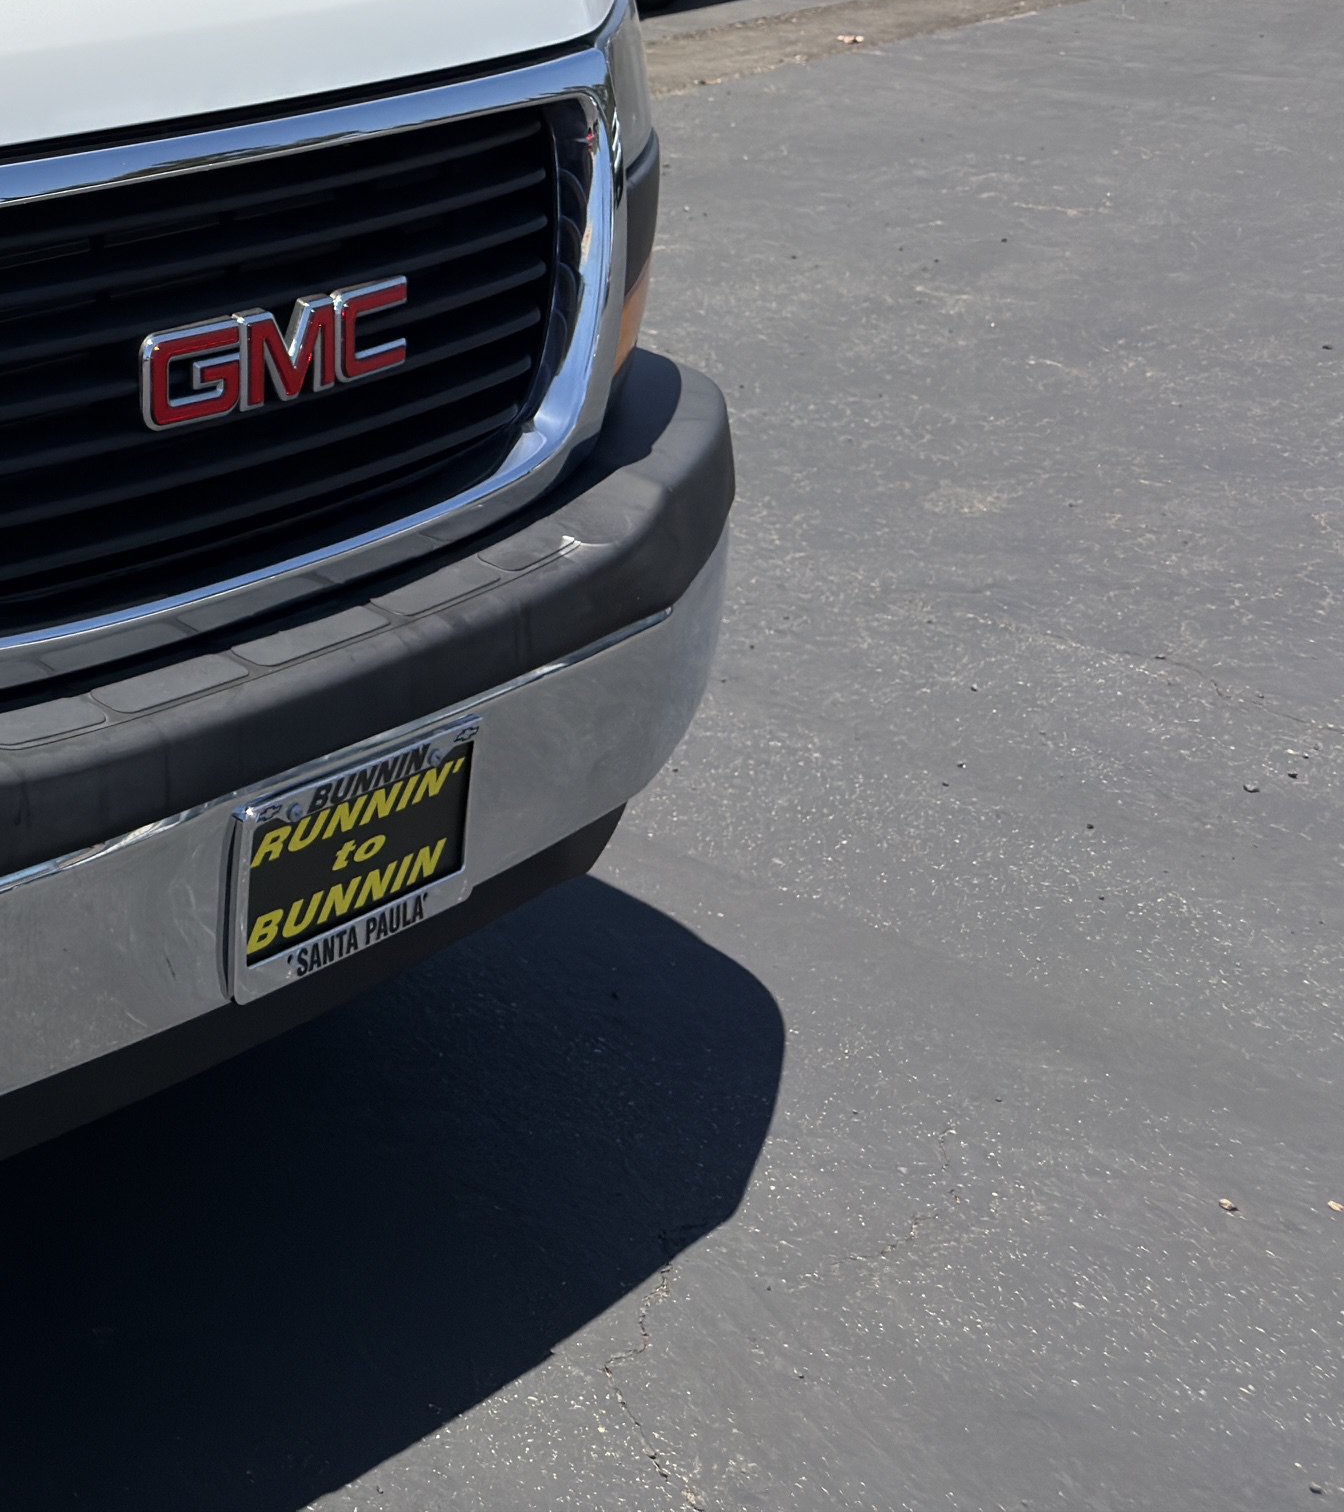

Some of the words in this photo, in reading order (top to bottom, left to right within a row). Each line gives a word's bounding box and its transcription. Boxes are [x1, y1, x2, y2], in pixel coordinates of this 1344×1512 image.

[139, 275, 408, 432] GMC
[249, 756, 466, 869] RUNNIN'
[307, 743, 431, 814] BUNNIN
[246, 837, 448, 956] BUNNIN
[332, 834, 387, 871] to
